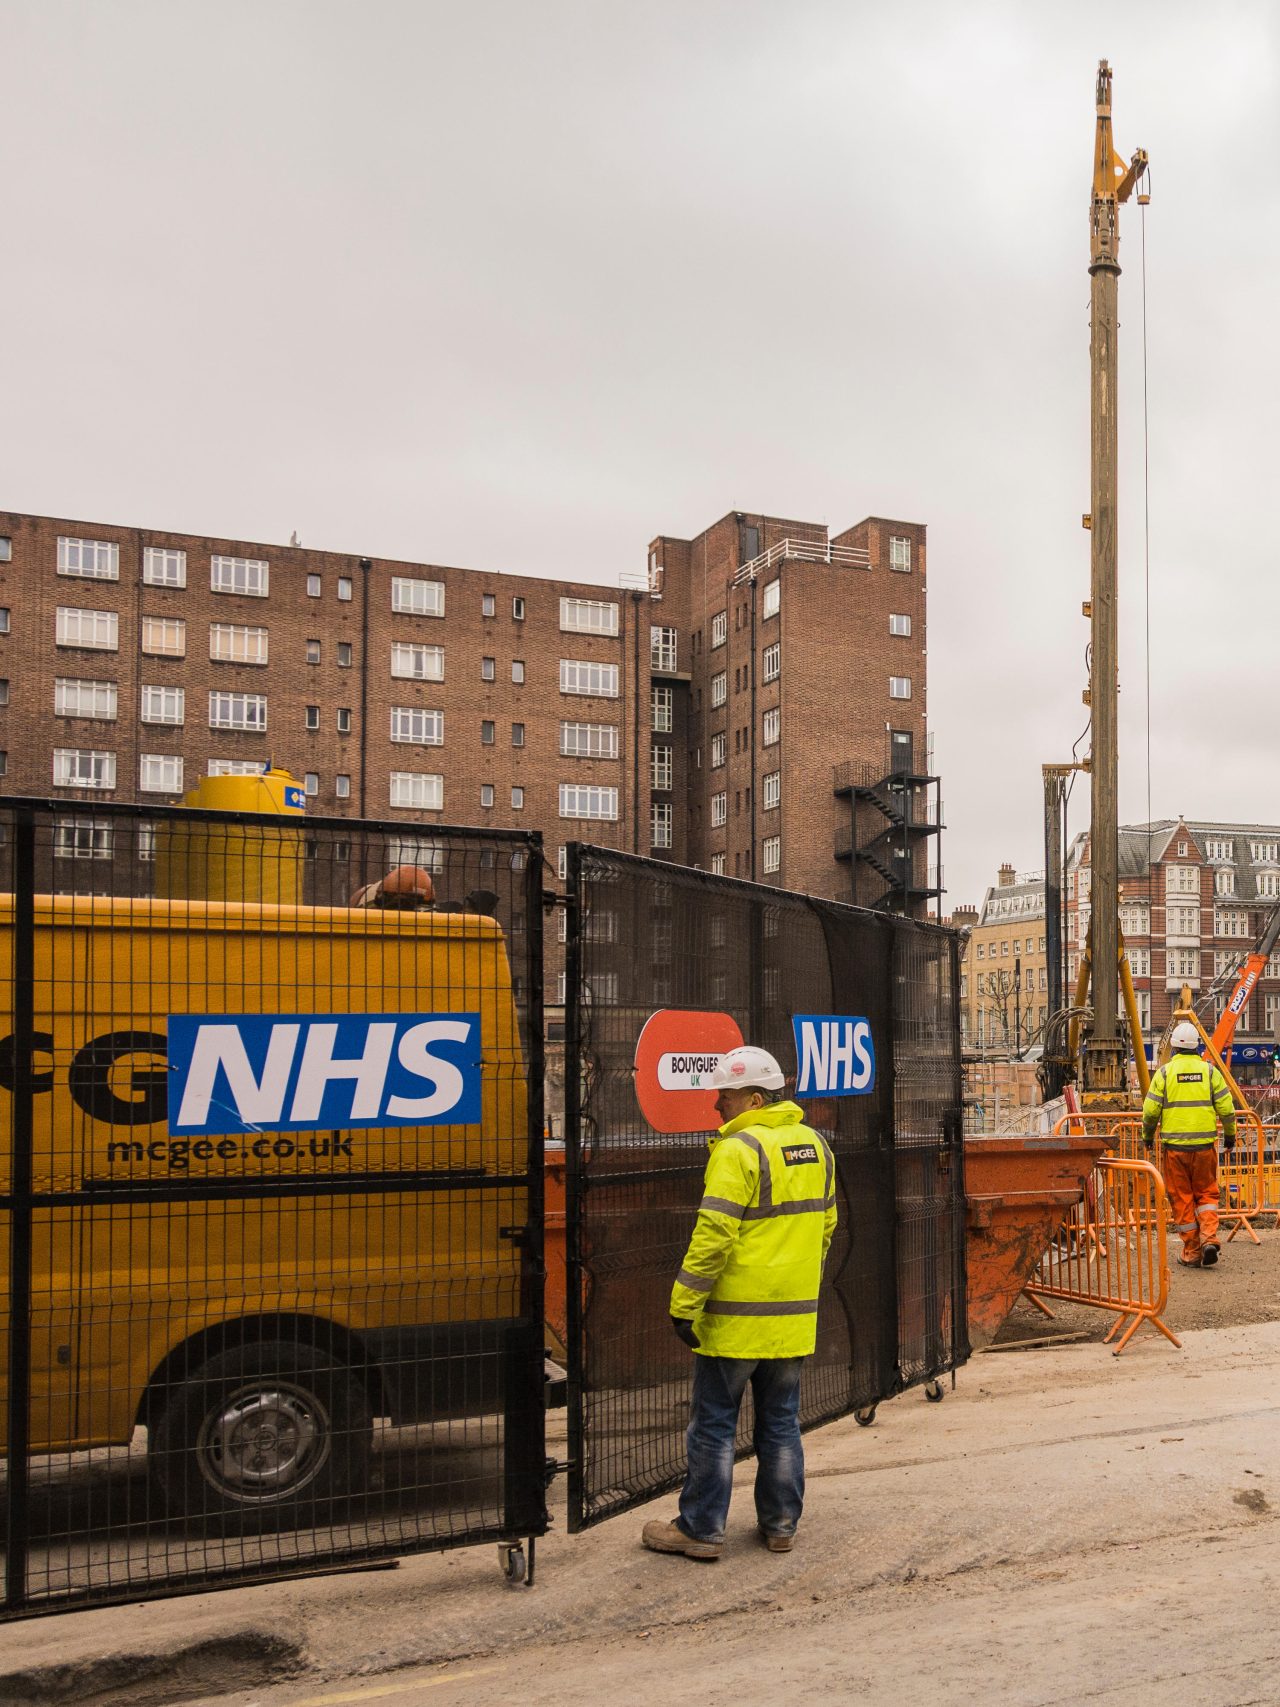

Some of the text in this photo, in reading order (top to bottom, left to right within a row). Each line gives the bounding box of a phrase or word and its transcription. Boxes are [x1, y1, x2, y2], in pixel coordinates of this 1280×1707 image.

[177, 1021, 471, 1126] NHS
[690, 1075, 701, 1087] UK
[798, 1020, 871, 1092] NHS
[107, 1129, 354, 1168] mcgee.co.uk
